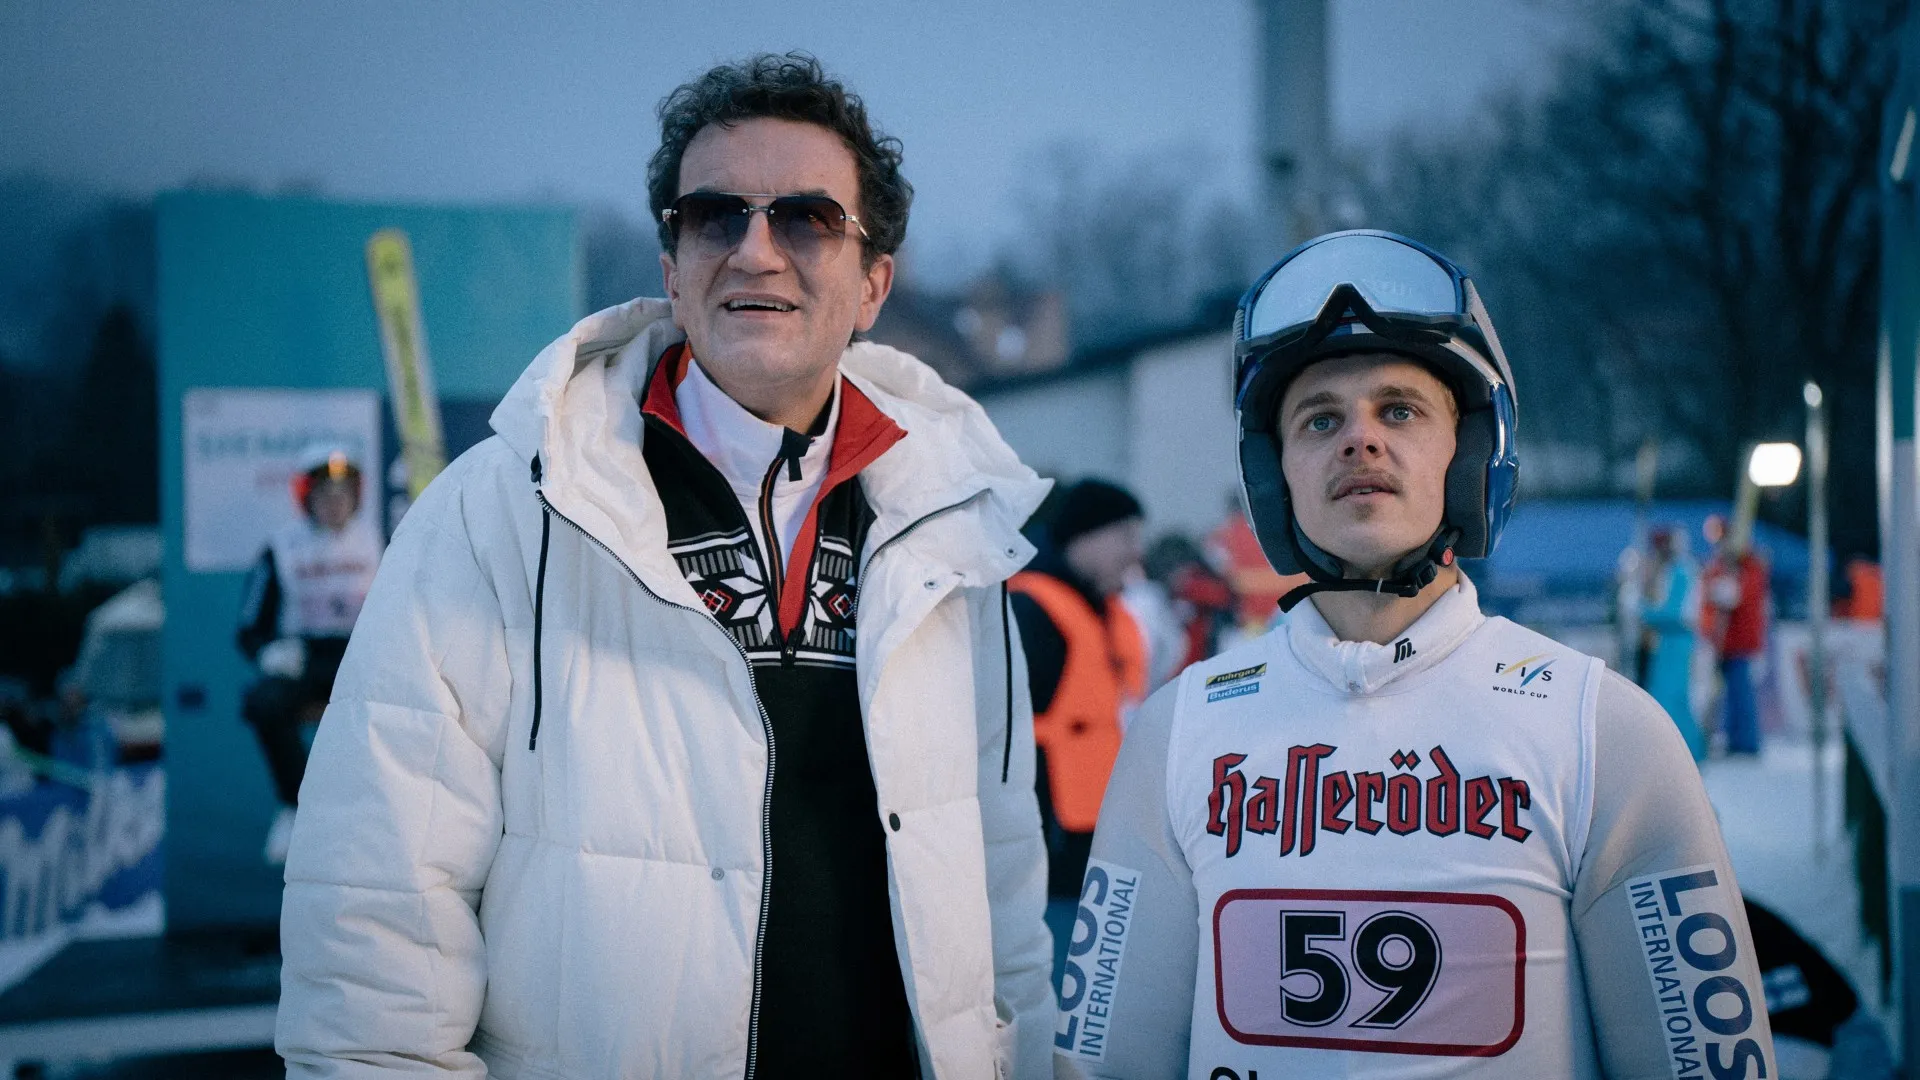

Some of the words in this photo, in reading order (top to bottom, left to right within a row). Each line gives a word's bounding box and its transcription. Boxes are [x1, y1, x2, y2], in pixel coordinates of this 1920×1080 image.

[1209, 684, 1257, 700] Buderus
[1216, 668, 1256, 682] ruhrgas
[1492, 685, 1526, 695] WORLD
[1530, 691, 1548, 699] CUP
[1495, 662, 1553, 682] FIS
[1053, 866, 1110, 1051] LOOS
[1079, 876, 1137, 1057] INTERNATIONAL
[1280, 909, 1443, 1030] 59
[1629, 881, 1704, 1080] INTERNATIONA
[1659, 869, 1768, 1080] LOOS
